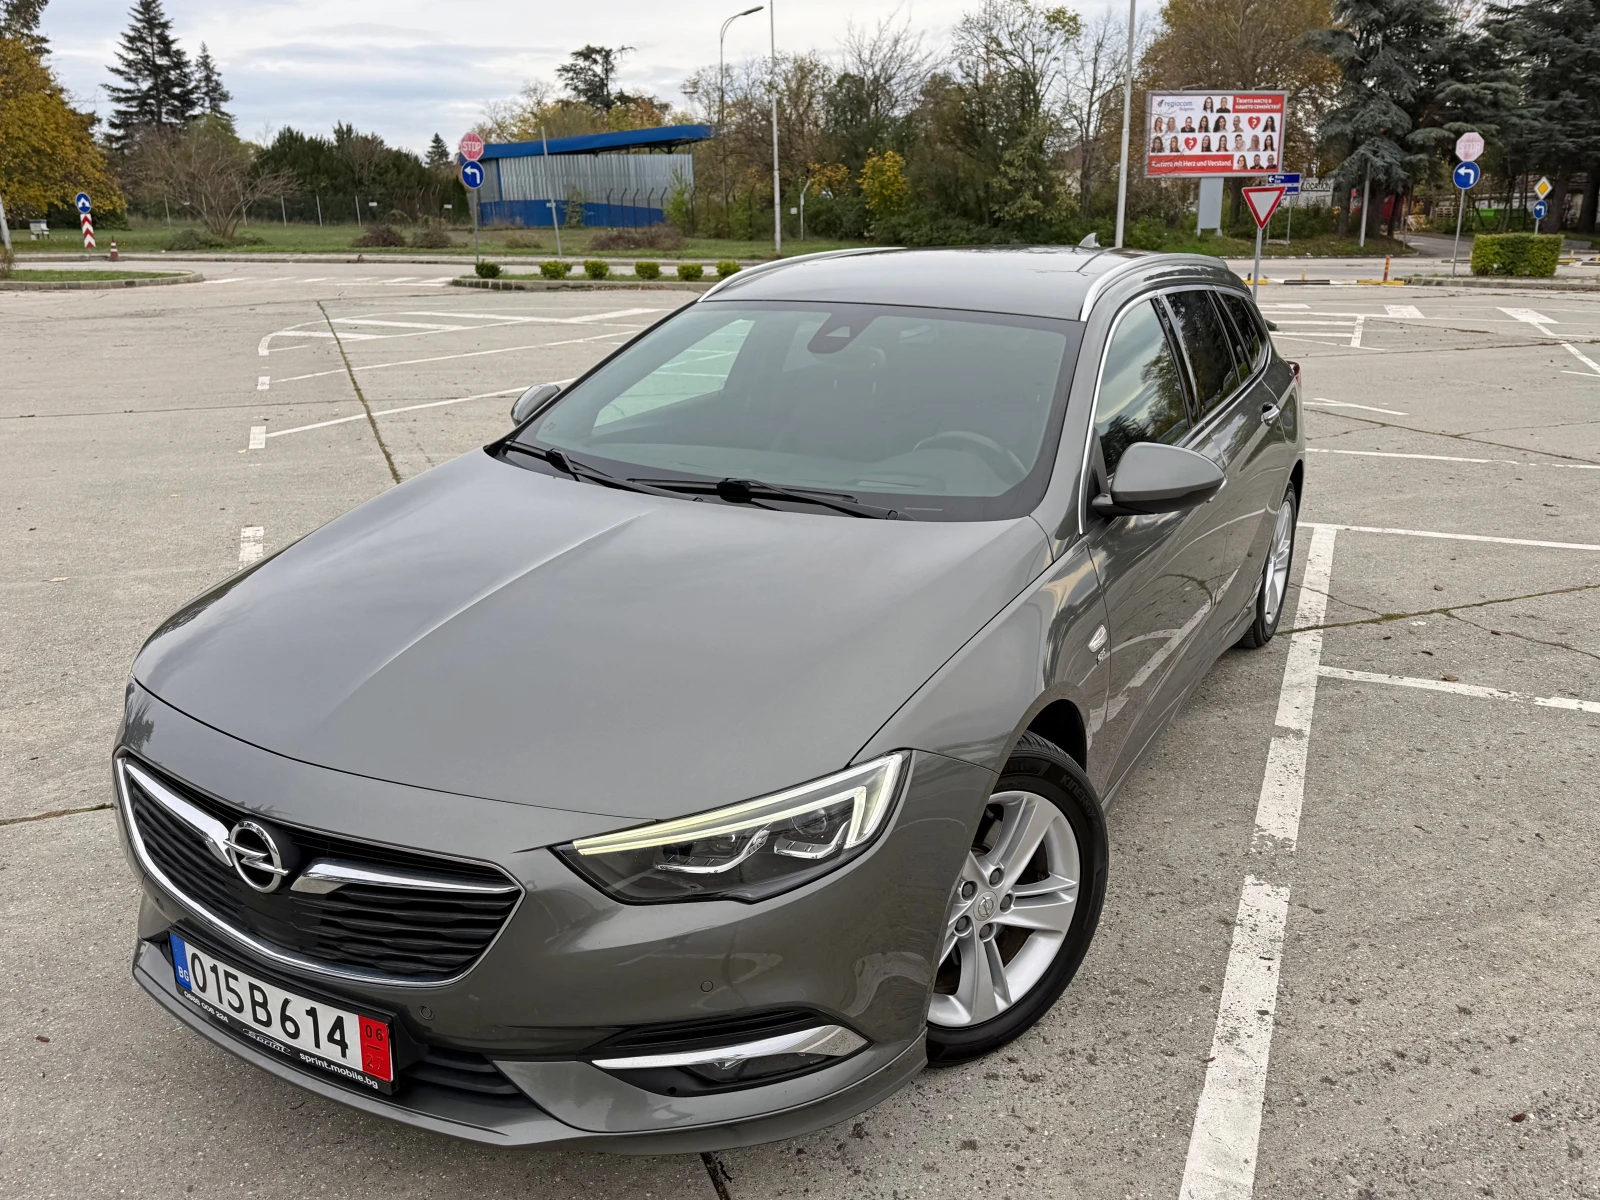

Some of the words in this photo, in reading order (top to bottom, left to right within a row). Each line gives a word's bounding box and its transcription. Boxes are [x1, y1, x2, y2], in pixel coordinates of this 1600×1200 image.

[1164, 100, 1193, 108] regiocom
[462, 141, 481, 151] STOP
[1459, 141, 1481, 152] STOP
[178, 966, 190, 982] BG
[190, 952, 349, 1060] 015B614
[365, 1024, 384, 1042] 06
[299, 1052, 379, 1090] sprint.mobile.bg
